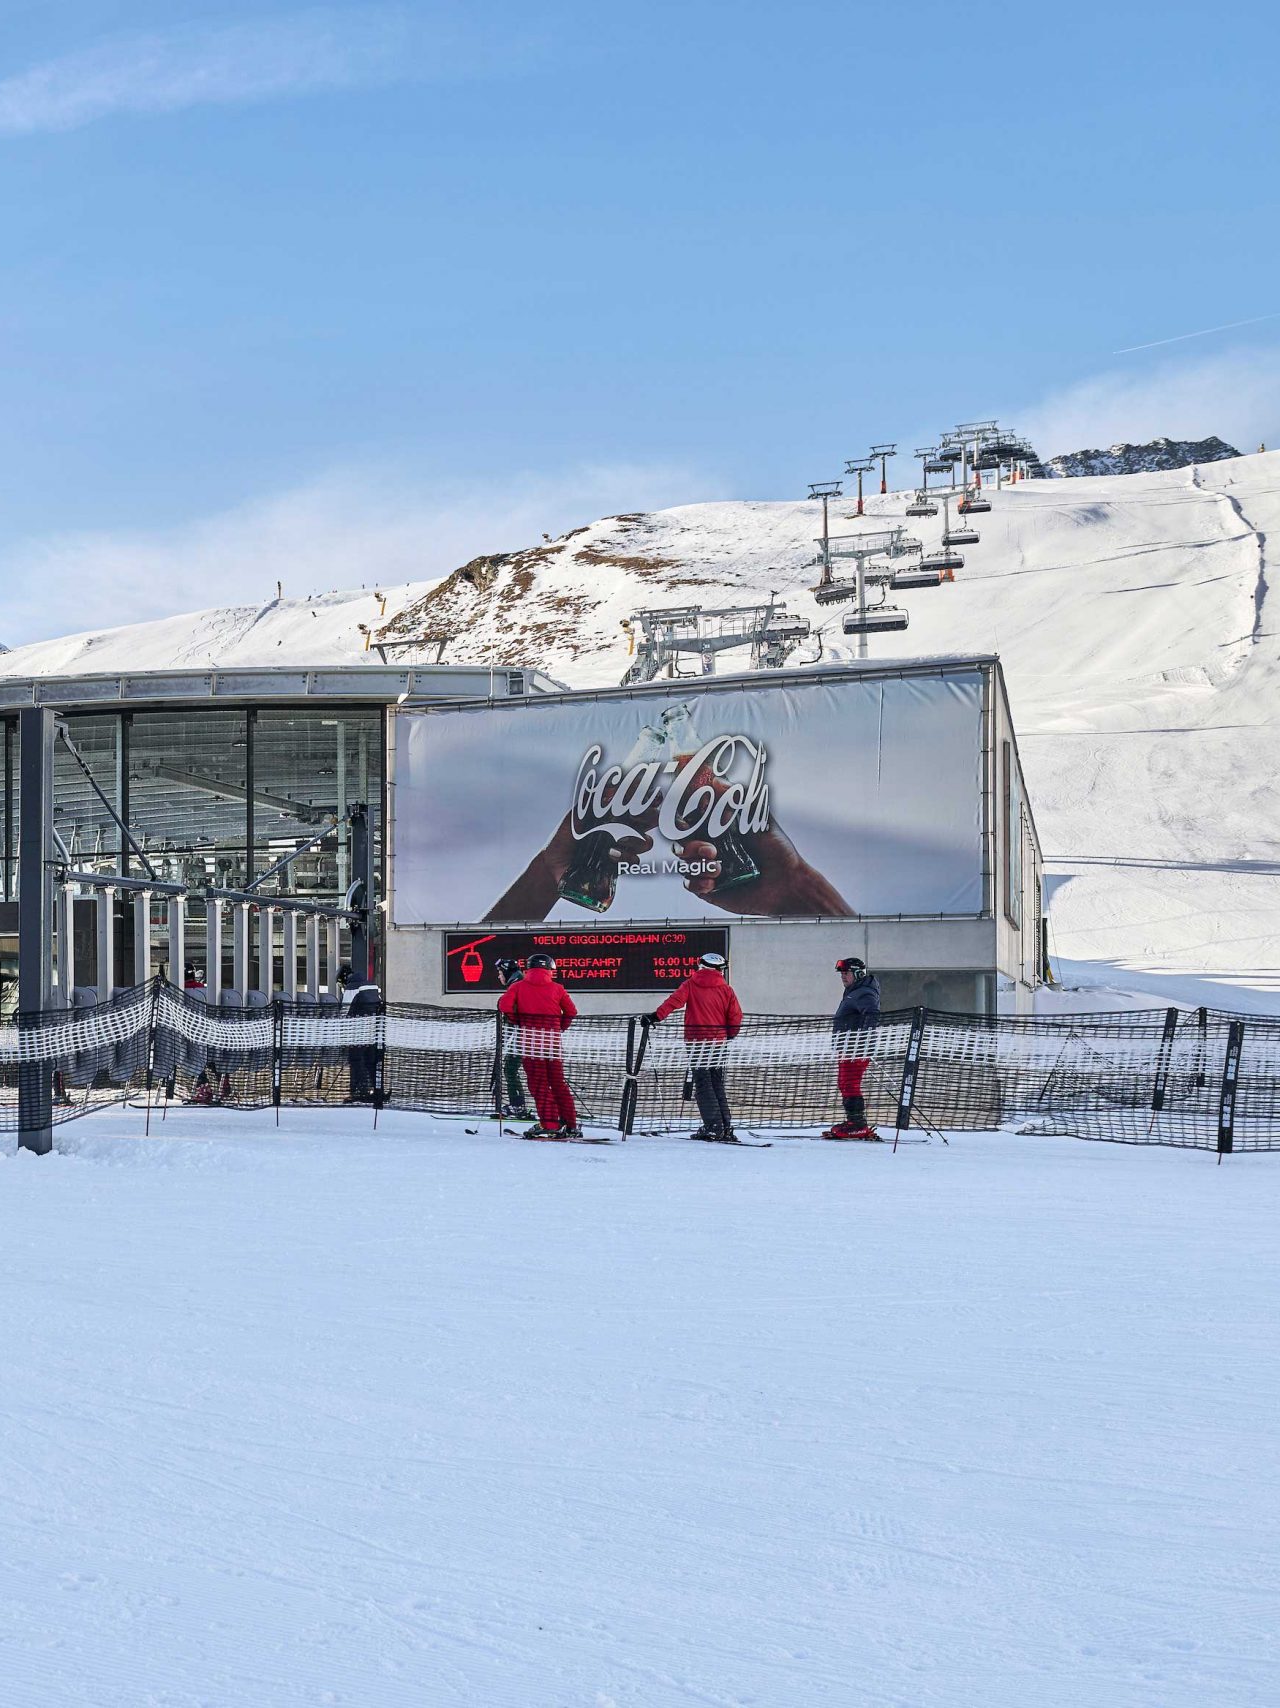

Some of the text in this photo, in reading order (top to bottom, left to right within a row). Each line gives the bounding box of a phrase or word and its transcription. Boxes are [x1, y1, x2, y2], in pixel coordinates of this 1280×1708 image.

[571, 735, 770, 842] Coca-Cola
[618, 861, 656, 875] Real
[569, 934, 660, 945] GIGGIJOCHBAHN
[556, 957, 623, 967] BERGFAHRT
[653, 957, 680, 966] 16.00
[560, 969, 618, 979] TALFAHRT
[654, 969, 680, 978] 16.30
